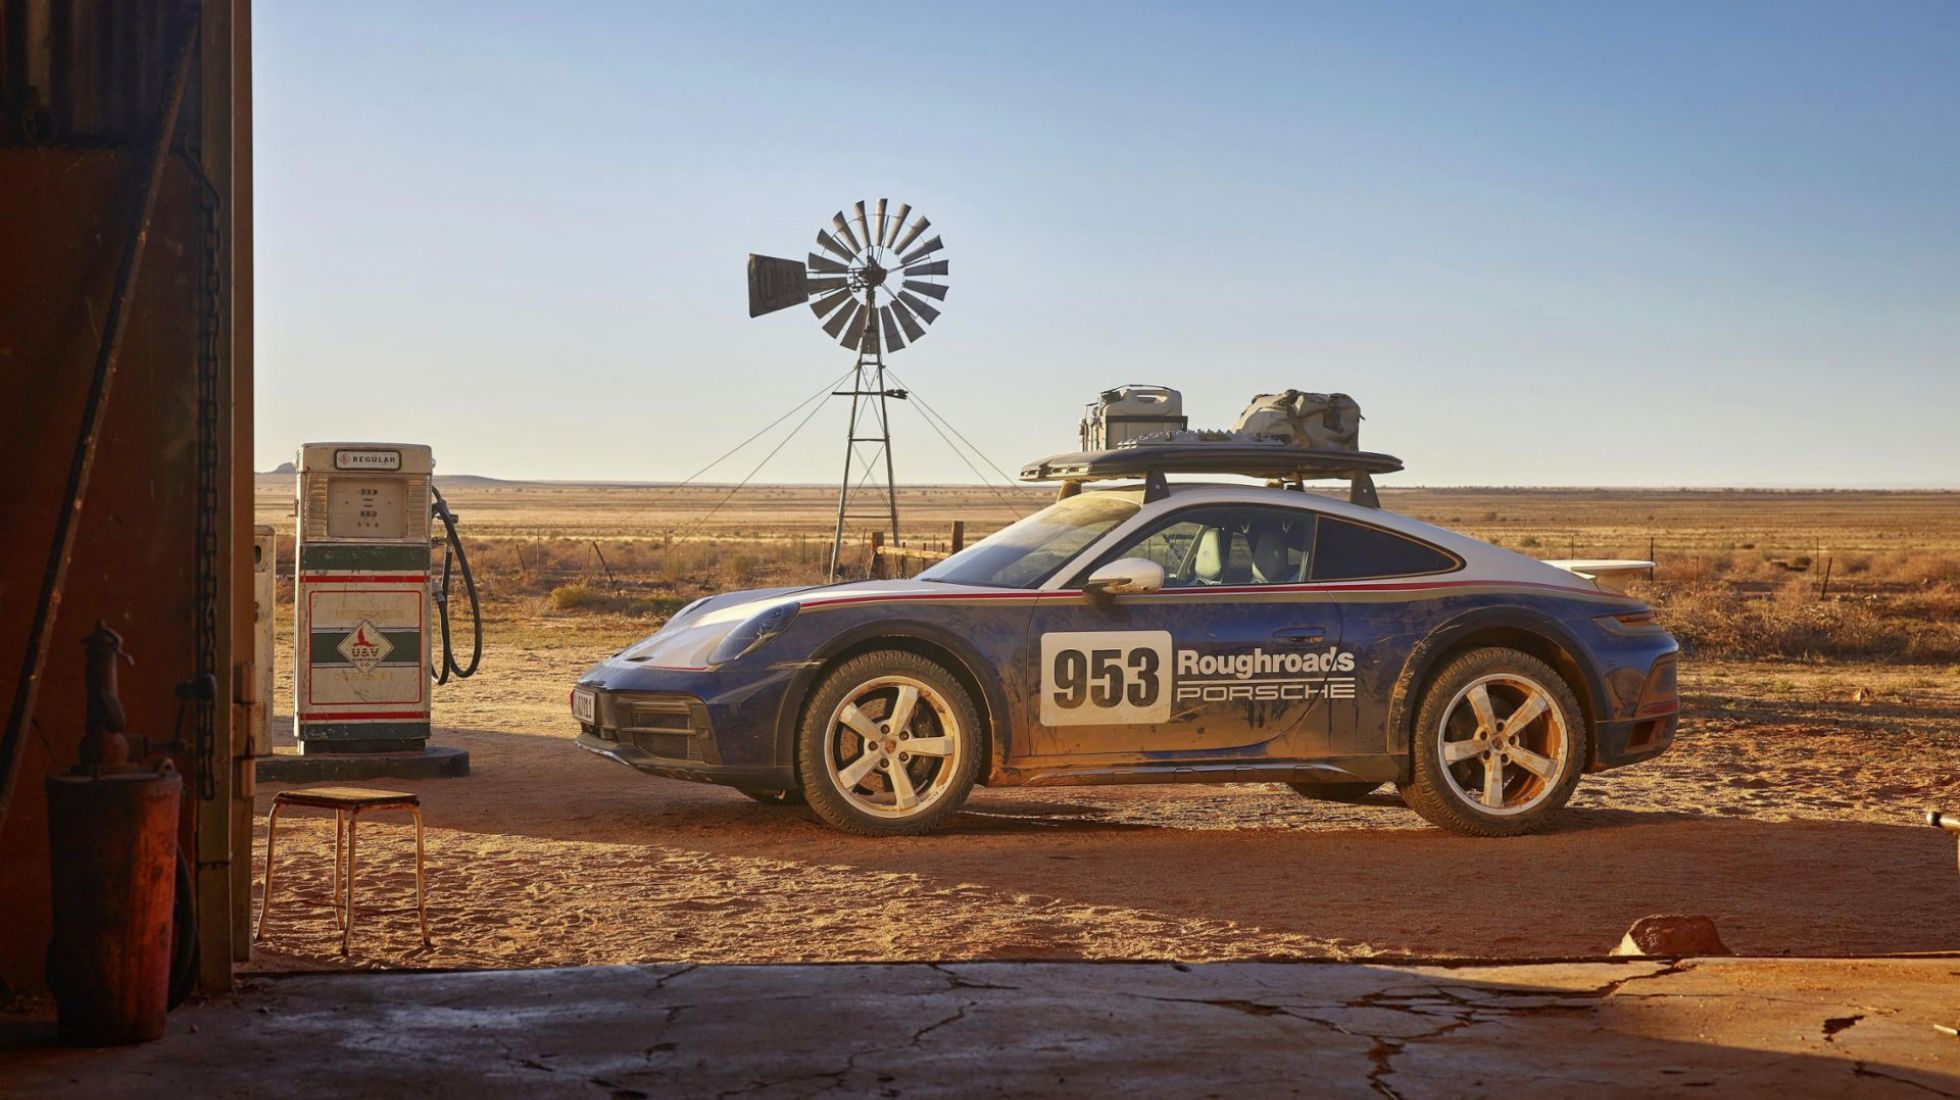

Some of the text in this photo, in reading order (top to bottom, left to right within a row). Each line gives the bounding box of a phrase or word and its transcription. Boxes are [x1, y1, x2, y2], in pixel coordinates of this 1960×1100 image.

[352, 648, 379, 657] U&V
[1177, 646, 1355, 679] Roughroads
[1053, 647, 1160, 709] 953
[1176, 684, 1355, 702] PORSCHE
